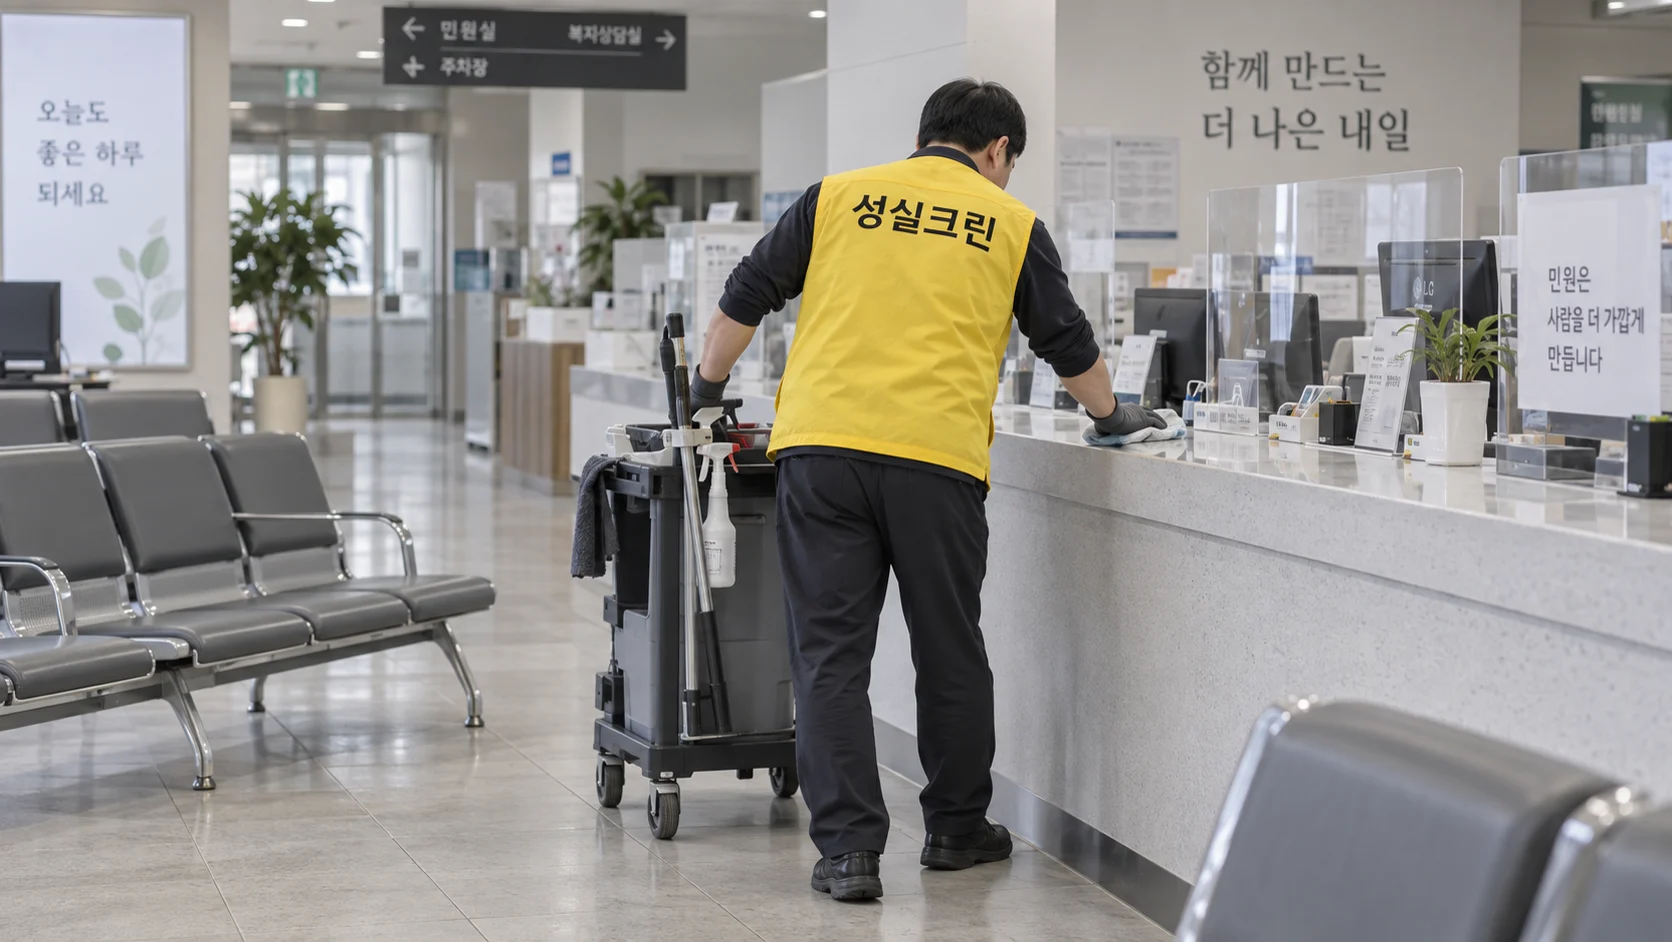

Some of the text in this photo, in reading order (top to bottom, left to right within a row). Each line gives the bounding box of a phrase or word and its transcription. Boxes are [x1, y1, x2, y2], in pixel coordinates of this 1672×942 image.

[440, 19, 496, 41] 민원실
[440, 57, 489, 77] 주차장
[1201, 49, 1387, 92] 함께 만드는
[37, 99, 109, 125] 오늘도
[1202, 106, 1410, 151] 더 나은 내일
[37, 139, 144, 167] 좋은 하루
[38, 180, 109, 206] 되세요
[852, 195, 996, 252] 성실크린
[1423, 280, 1434, 296] LG
[1548, 265, 1592, 293] 민원은
[1548, 306, 1644, 334] 사람을 더 가깝게
[1547, 344, 1603, 373] 만듭니다
